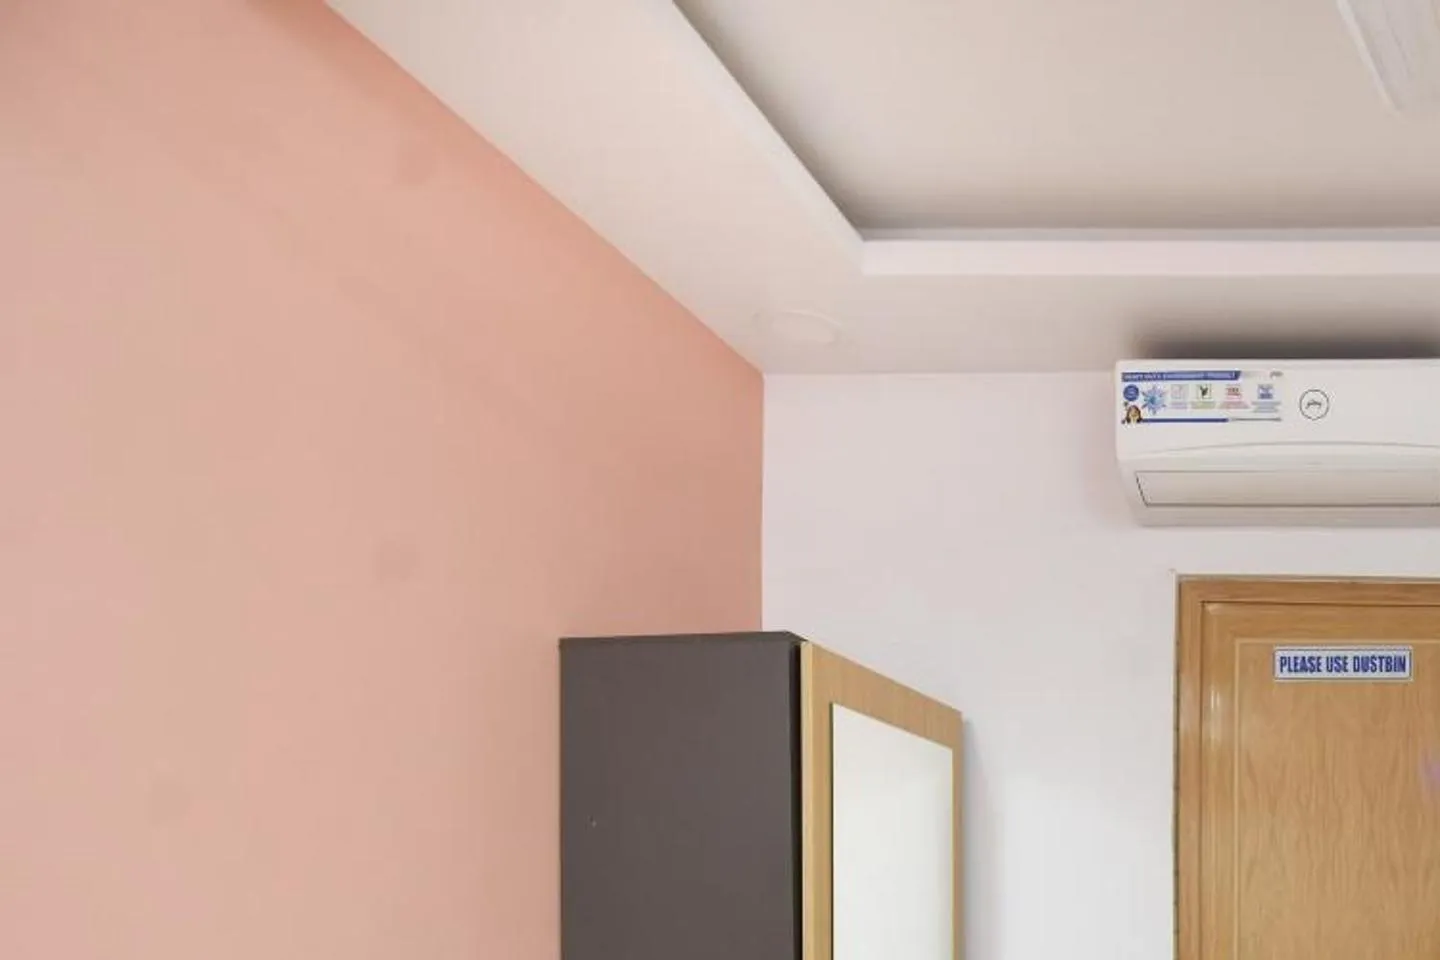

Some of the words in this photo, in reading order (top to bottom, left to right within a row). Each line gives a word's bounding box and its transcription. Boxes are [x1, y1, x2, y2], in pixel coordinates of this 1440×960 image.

[1280, 656, 1322, 673] PLEASE
[1326, 656, 1349, 673] USE
[1353, 656, 1406, 673] DUSTBIN
